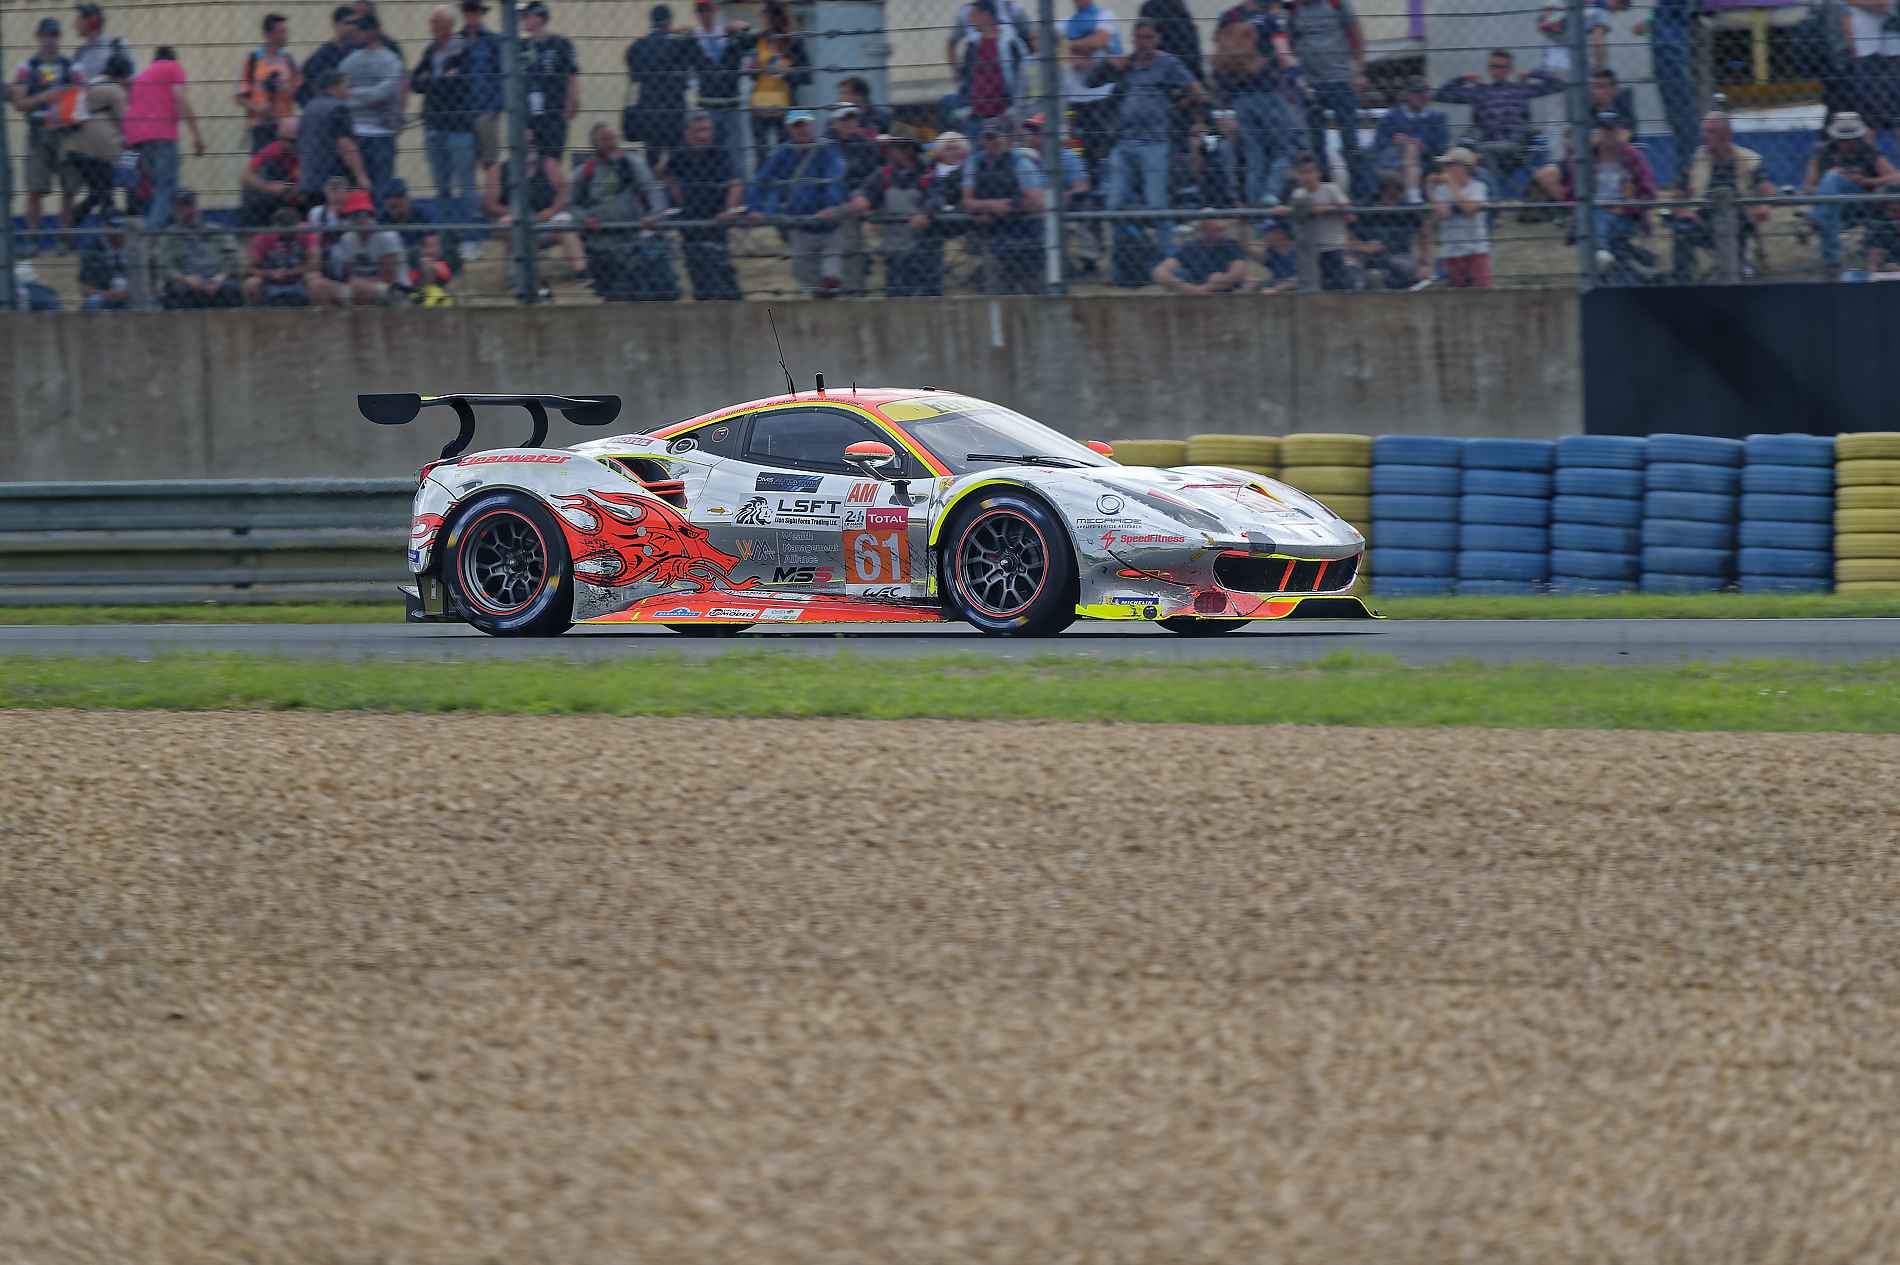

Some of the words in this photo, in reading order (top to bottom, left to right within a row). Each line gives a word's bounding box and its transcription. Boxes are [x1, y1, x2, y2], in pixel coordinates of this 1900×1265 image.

[847, 483, 879, 503] AM
[777, 499, 842, 513] LSFT
[868, 513, 906, 524] TOTAL
[1120, 534, 1185, 544] SpeedFitness
[855, 532, 902, 580] 61
